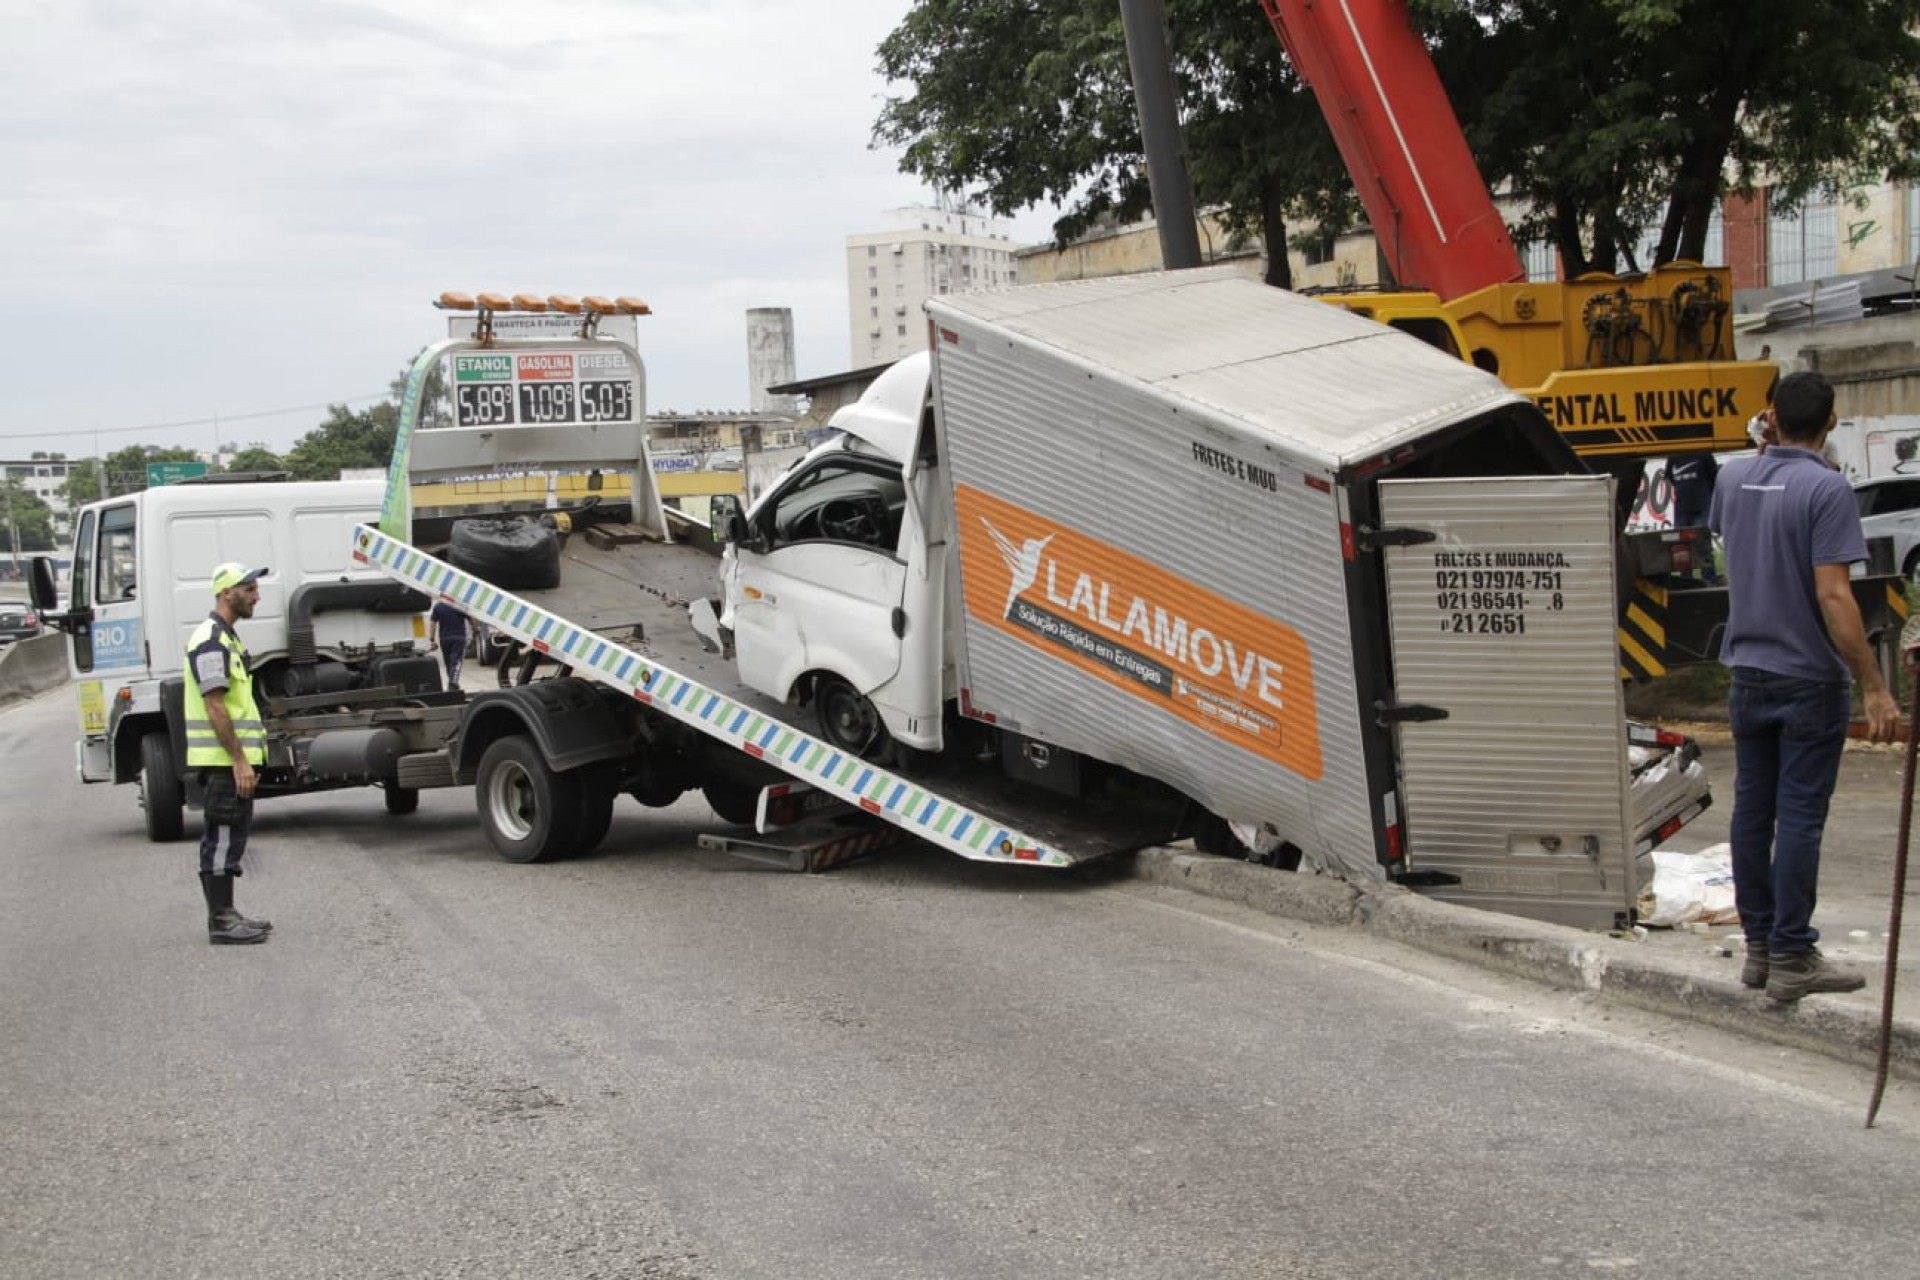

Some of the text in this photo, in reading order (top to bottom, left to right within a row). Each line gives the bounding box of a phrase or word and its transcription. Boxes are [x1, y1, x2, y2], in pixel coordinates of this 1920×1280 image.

[457, 358, 510, 371] ETANOL
[519, 356, 571, 370] GASOLINA
[580, 355, 629, 368] DIESEL
[1533, 387, 1739, 426] ENTAL MUNCK
[653, 458, 694, 469] HYUNDAI
[1192, 441, 1277, 492] FRETES E MUD
[1485, 553, 1492, 567] E
[1436, 571, 1467, 589] 021
[1437, 592, 1467, 609] 021
[1478, 613, 1525, 633] 2651
[95, 626, 125, 647] RIO
[1046, 559, 1284, 709] LALAMOVE
[1018, 605, 1161, 685] Solução Rápida em Entregas
